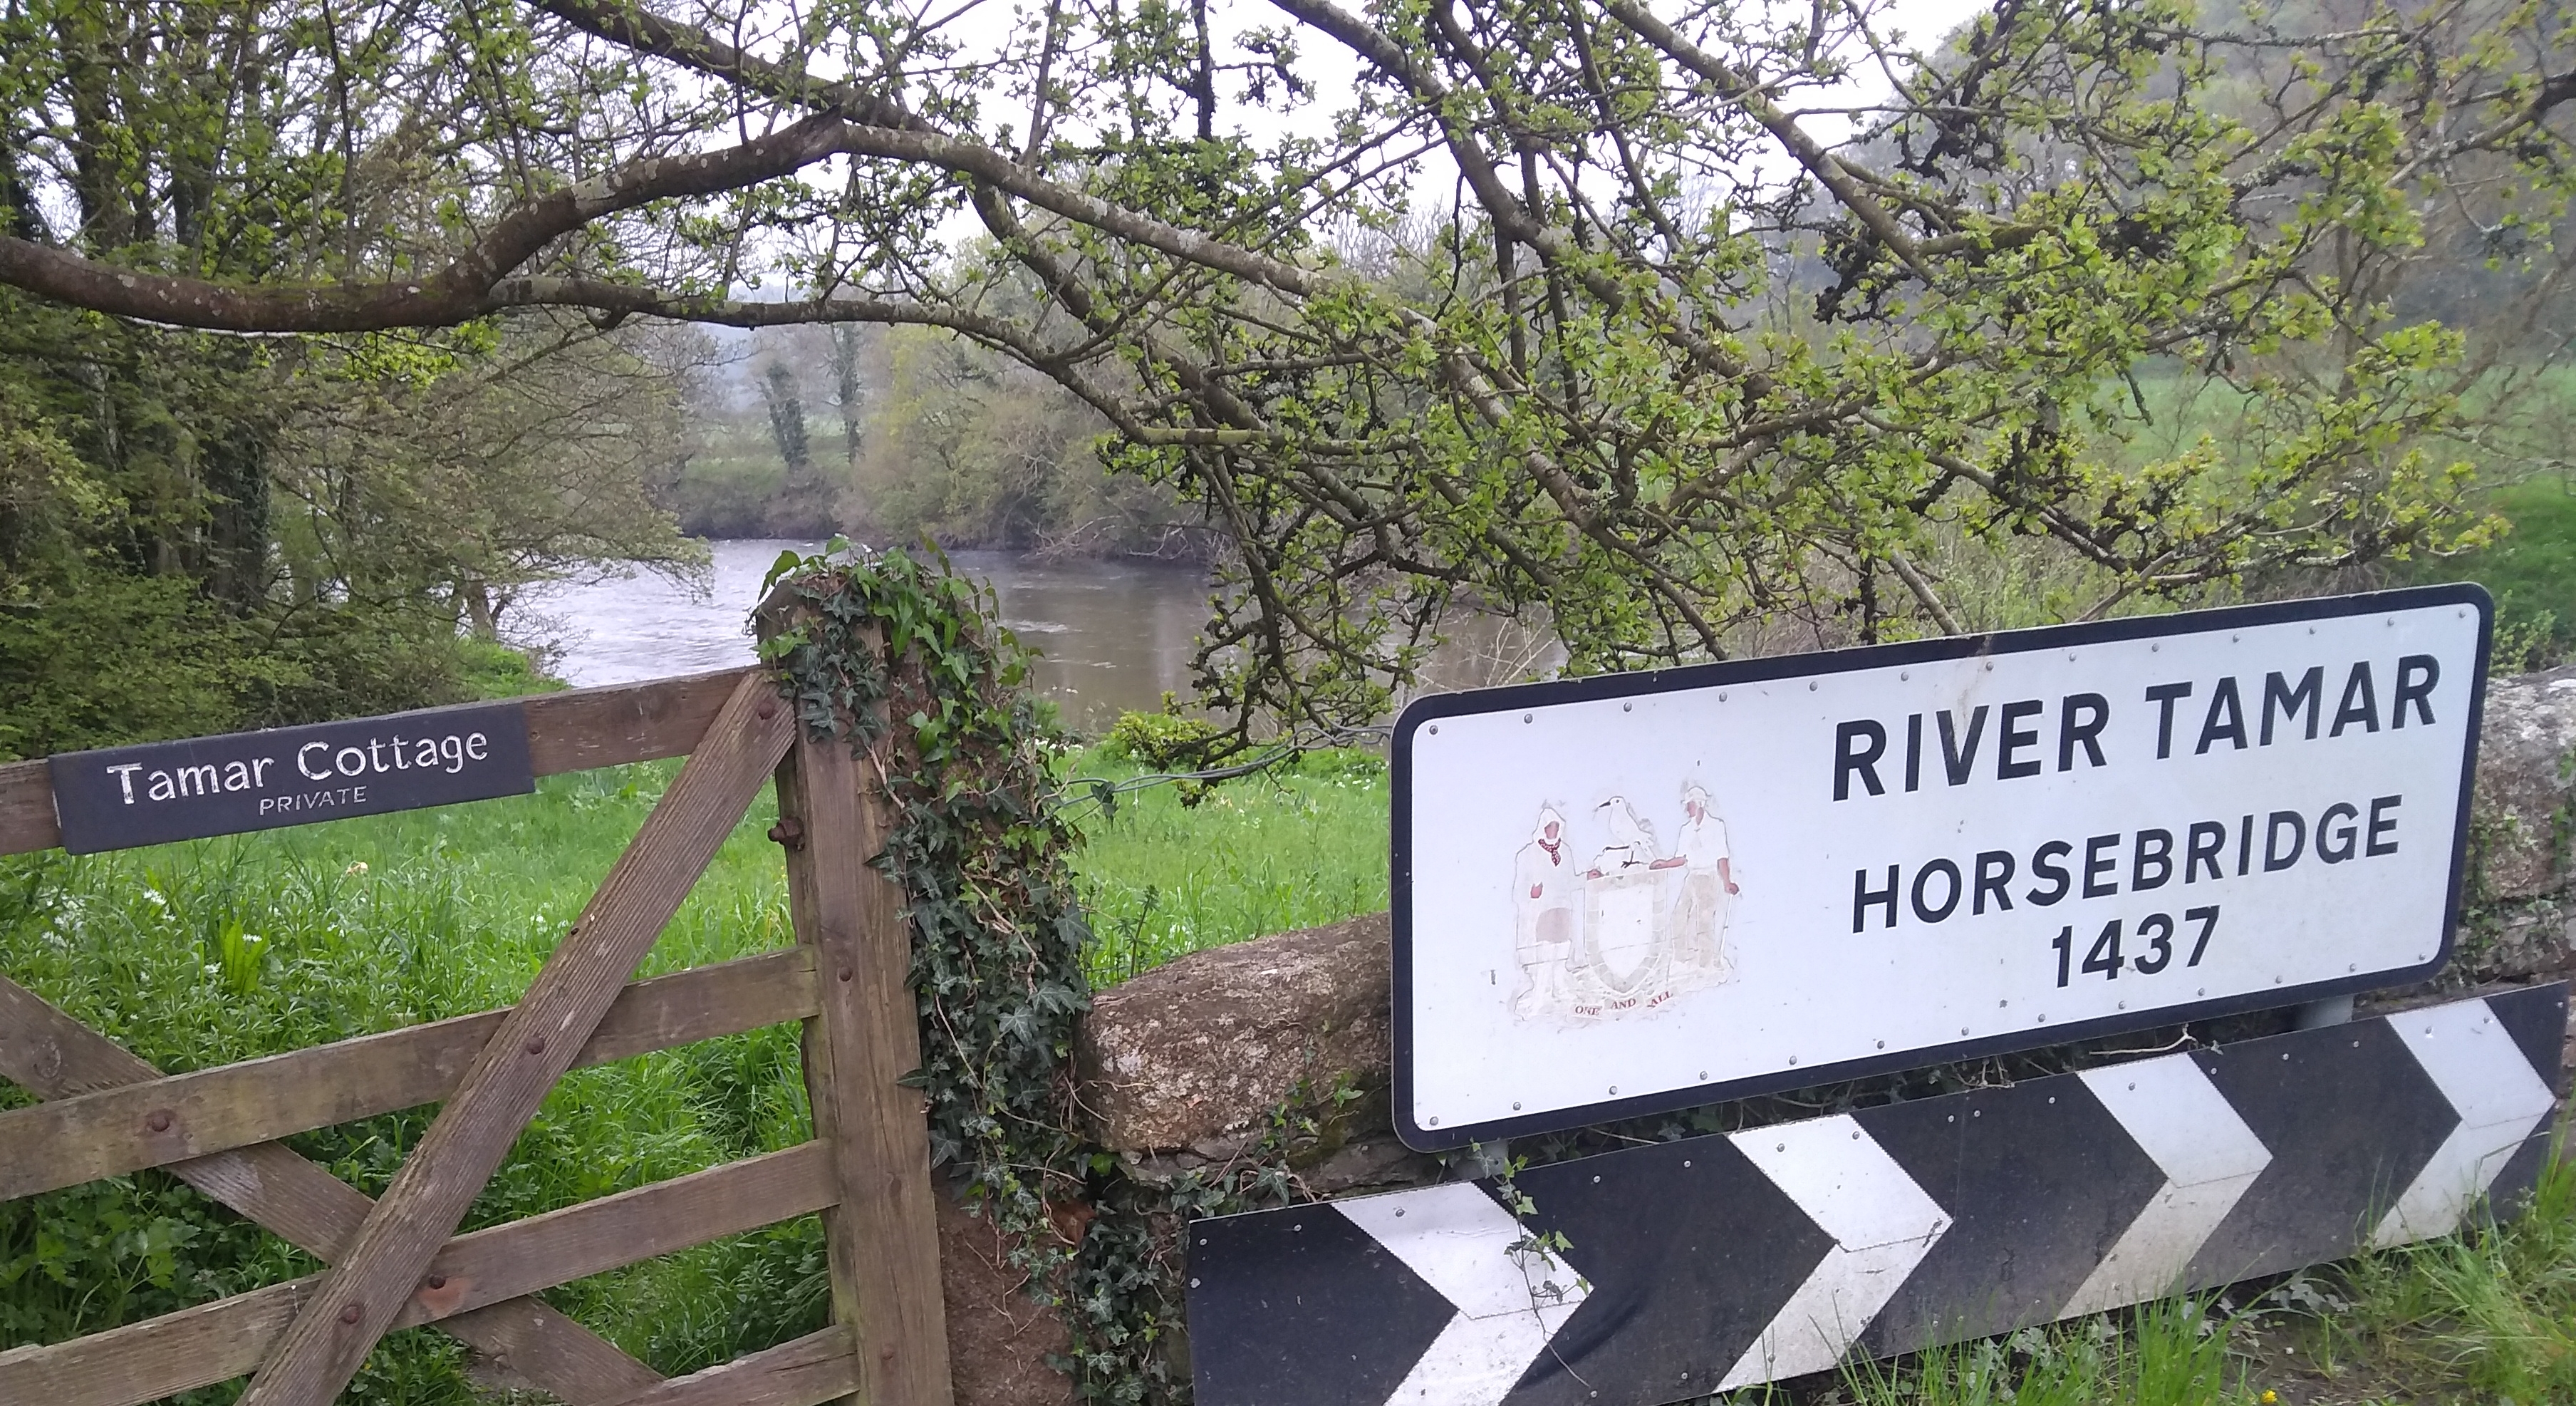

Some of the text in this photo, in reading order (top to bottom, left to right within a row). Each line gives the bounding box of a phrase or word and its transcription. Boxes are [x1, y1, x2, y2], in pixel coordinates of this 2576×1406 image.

[1833, 653, 2441, 802] RIVER TAMAR
[107, 732, 488, 805] Tamar Cottage
[259, 785, 368, 816] PRIVATE
[1853, 794, 2403, 934] HORSEBRIDGE
[2052, 905, 2221, 988] 1437
[1574, 991, 1673, 1016] ONE AND ALL
